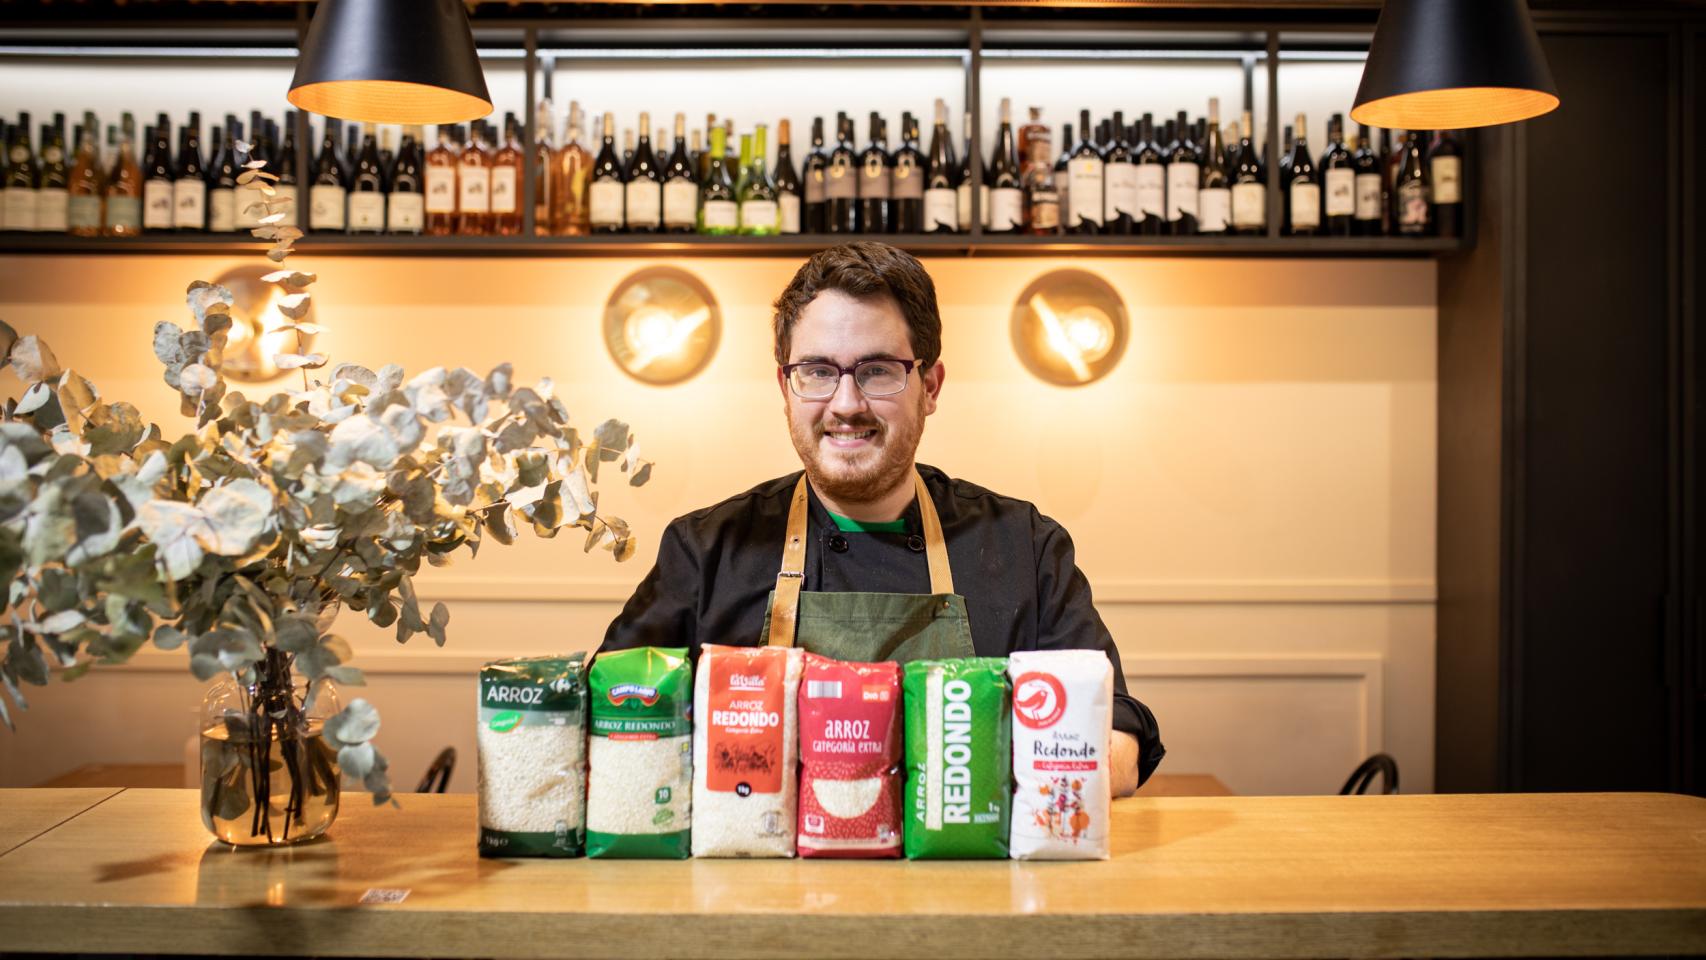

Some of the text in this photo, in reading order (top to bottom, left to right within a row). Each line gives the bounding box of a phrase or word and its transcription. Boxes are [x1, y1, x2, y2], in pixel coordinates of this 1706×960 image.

[487, 686, 543, 704] ARROZ
[729, 700, 764, 711] ARROZ
[594, 720, 676, 730] ARROZ REDONDO
[712, 711, 780, 728] REDONDO
[944, 679, 972, 824] REDONDO
[1034, 741, 1096, 758] Redondo
[658, 788, 669, 800] 10
[916, 761, 927, 822] ARROZ
